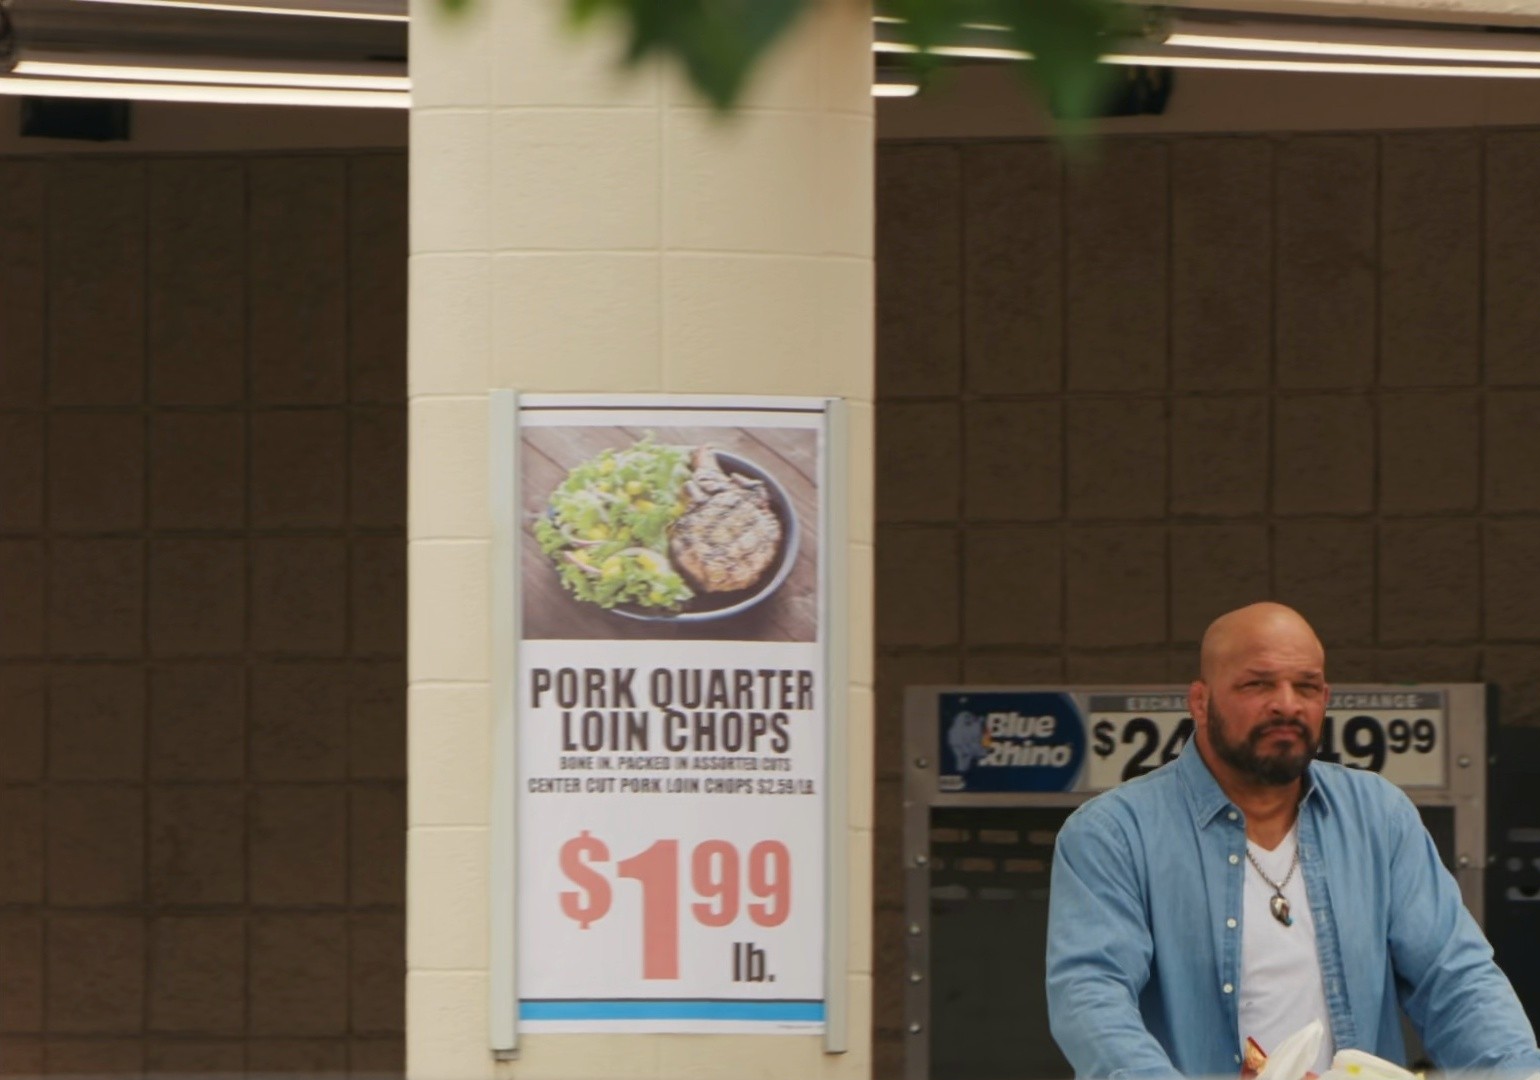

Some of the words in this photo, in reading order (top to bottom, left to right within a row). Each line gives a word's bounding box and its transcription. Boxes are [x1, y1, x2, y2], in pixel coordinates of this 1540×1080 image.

[531, 667, 636, 708] PORK
[650, 667, 814, 713] QUARTER
[1332, 693, 1419, 707] XCHANGE
[561, 709, 648, 752] LOIN
[662, 711, 790, 754] CHOPS
[985, 711, 1055, 738] Blue
[560, 756, 594, 770] BONE
[618, 756, 671, 770] PACKED
[674, 757, 688, 770] IN
[692, 756, 757, 771] ASSORTED
[761, 758, 791, 772] CUTS
[977, 740, 1074, 768] Rhino
[528, 777, 582, 793] CENTER
[586, 777, 614, 793] CUT
[619, 777, 662, 793] PORK
[666, 778, 698, 793] LOIN
[705, 778, 753, 794] CHOPS
[731, 941, 776, 982] lb.
